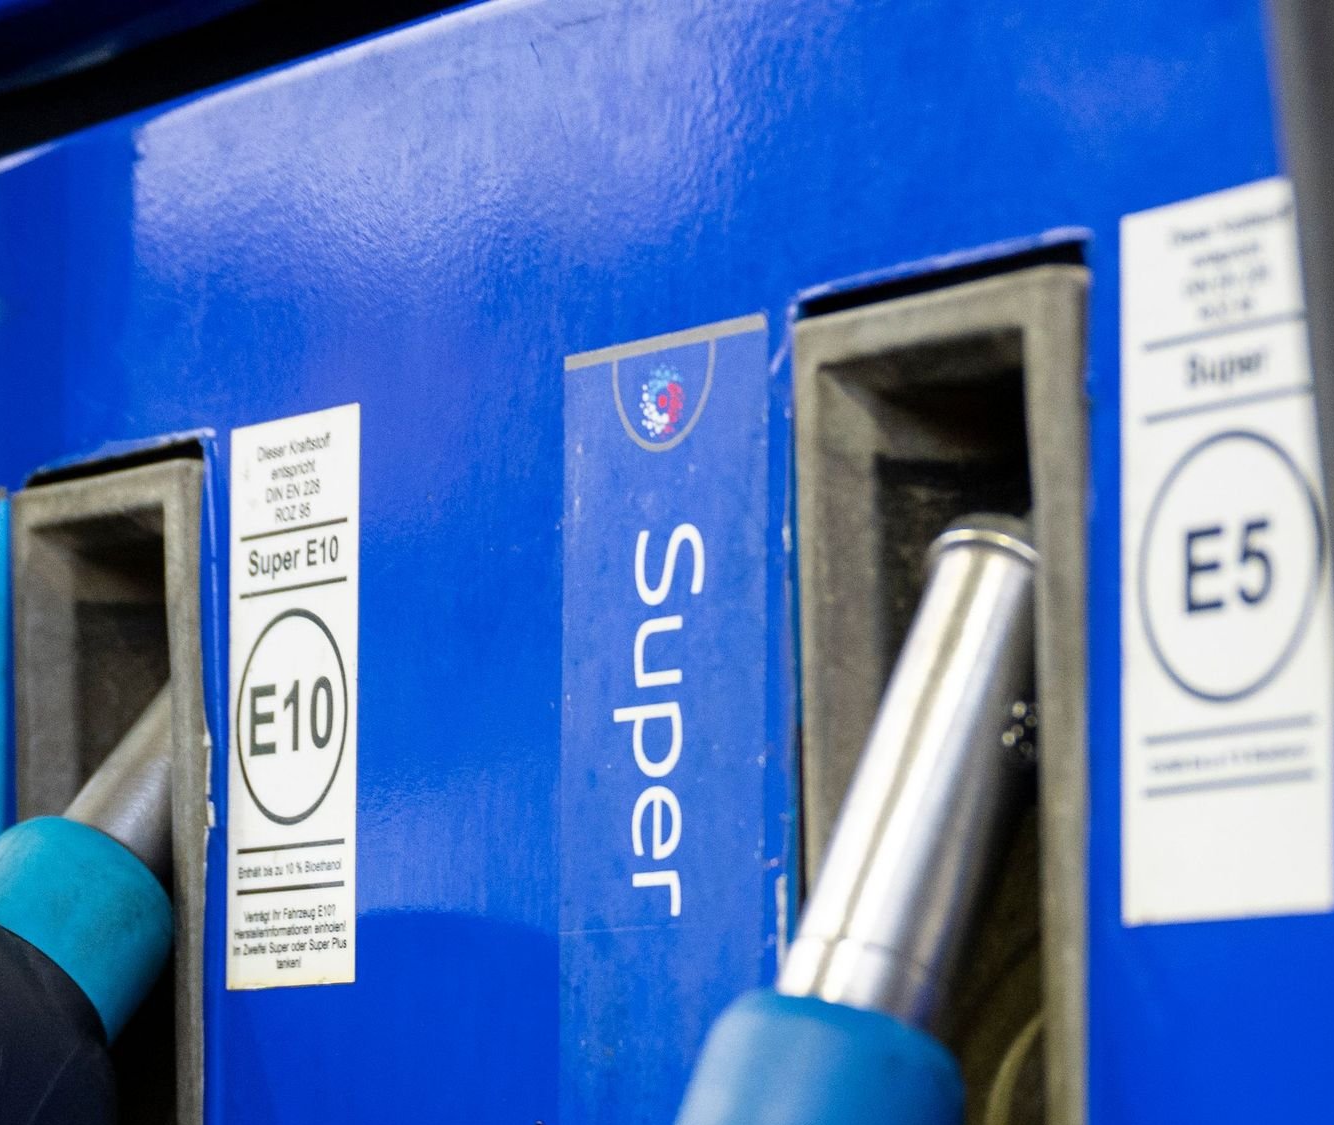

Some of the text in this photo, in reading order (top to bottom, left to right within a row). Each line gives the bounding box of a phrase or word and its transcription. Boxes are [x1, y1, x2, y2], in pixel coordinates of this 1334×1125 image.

[1186, 352, 1264, 388] Super
[266, 486, 283, 503] DIN
[286, 481, 300, 499] EN
[248, 535, 339, 580] Super E10
[1185, 519, 1273, 614] E5
[249, 675, 335, 757] E10
[613, 523, 705, 916] Super
[283, 907, 316, 921] Fahrzeug
[269, 942, 288, 955] Super
[291, 940, 307, 952] oder
[309, 938, 330, 952] Super
[332, 937, 347, 949] Plus
